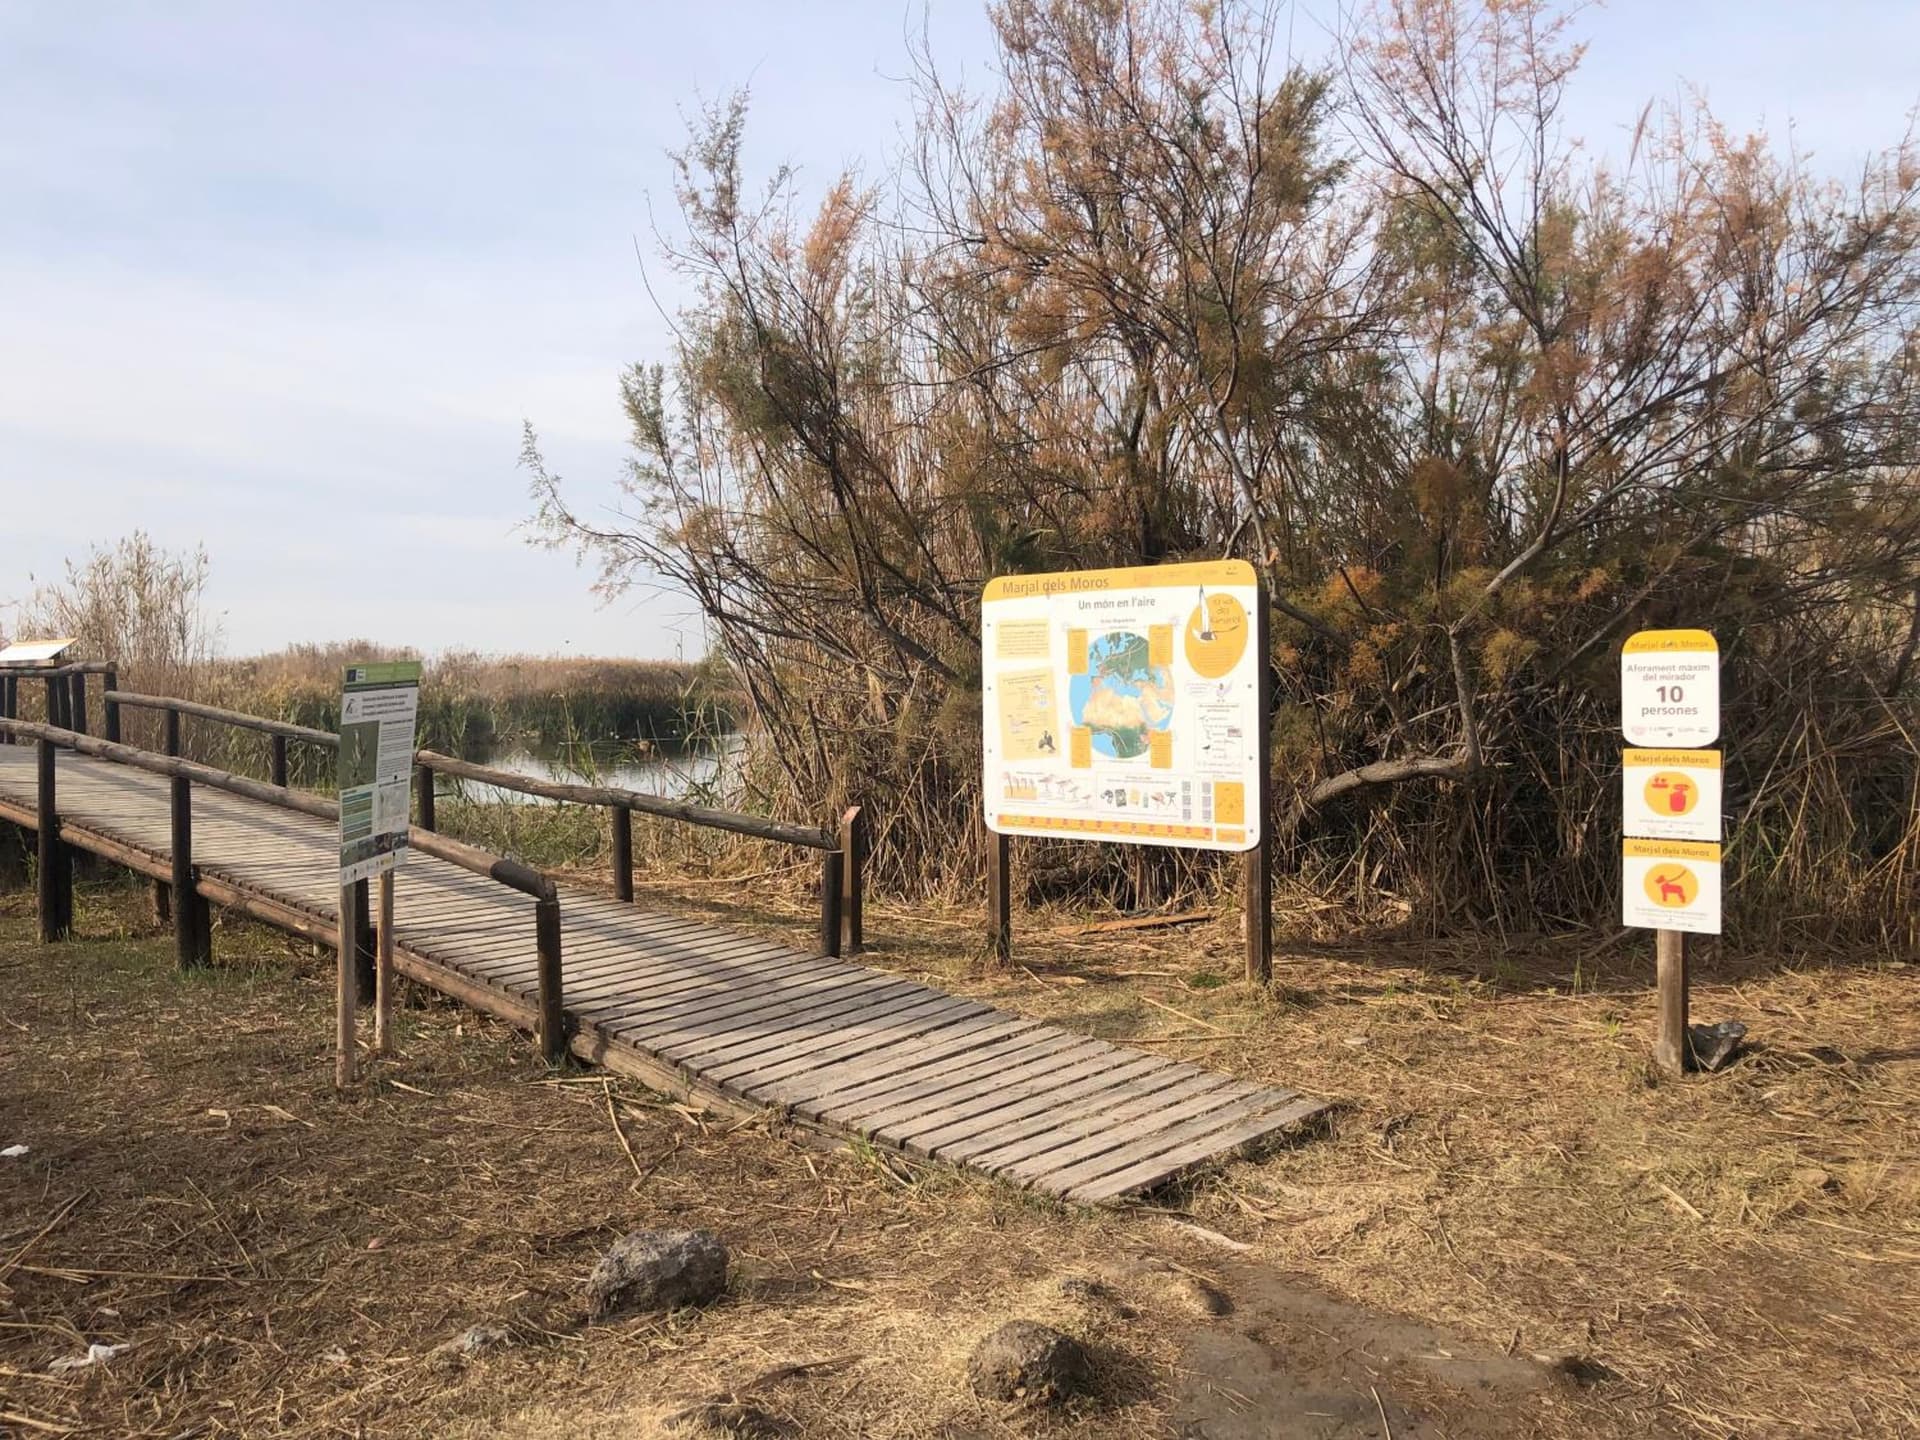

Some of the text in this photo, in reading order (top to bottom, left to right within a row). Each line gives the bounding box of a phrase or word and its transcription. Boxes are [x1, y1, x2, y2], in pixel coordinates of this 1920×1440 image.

[1002, 577, 1109, 596] Marjal dels Moros
[1078, 596, 1156, 610] Un món en l'aire
[1626, 664, 1676, 672] Aforament
[1642, 673, 1696, 681] del mirador
[1656, 685, 1684, 703] 10
[1641, 706, 1698, 717] persones
[1633, 754, 1710, 765] Marjal dels Moros
[1633, 845, 1710, 857] Marjal dels Moros
